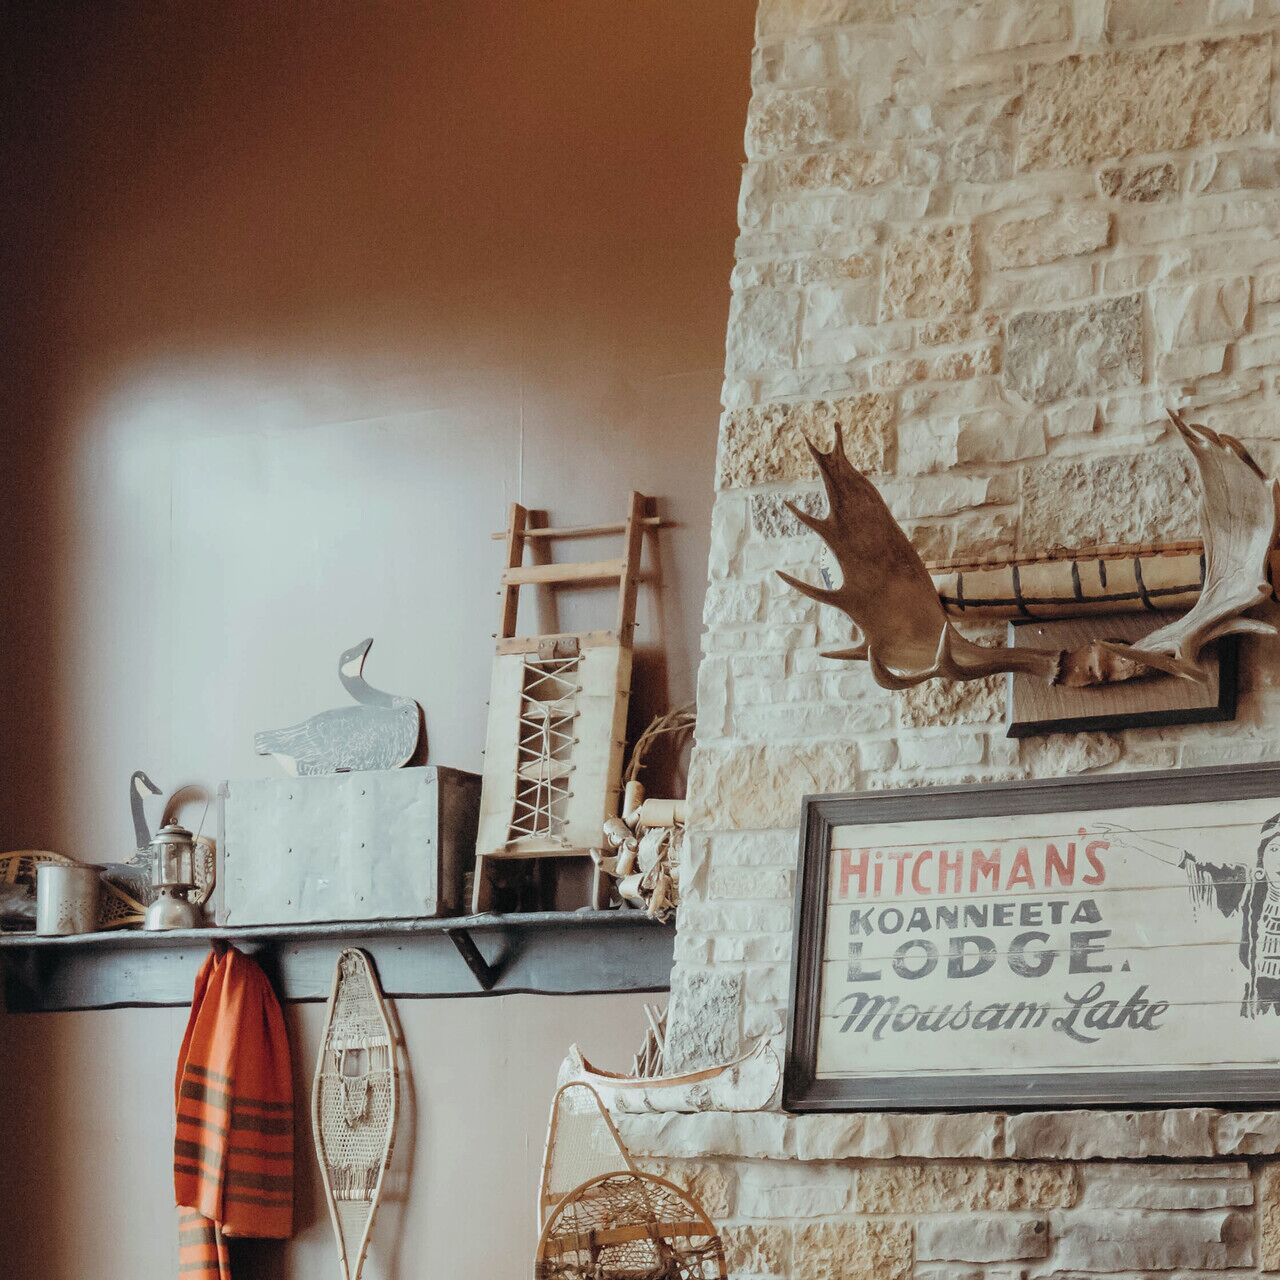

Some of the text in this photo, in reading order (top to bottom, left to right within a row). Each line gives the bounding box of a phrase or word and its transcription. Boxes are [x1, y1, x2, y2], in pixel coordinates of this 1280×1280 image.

[848, 898, 1103, 937] KOANNEETA
[832, 981, 1170, 1044] Mousam Lake
